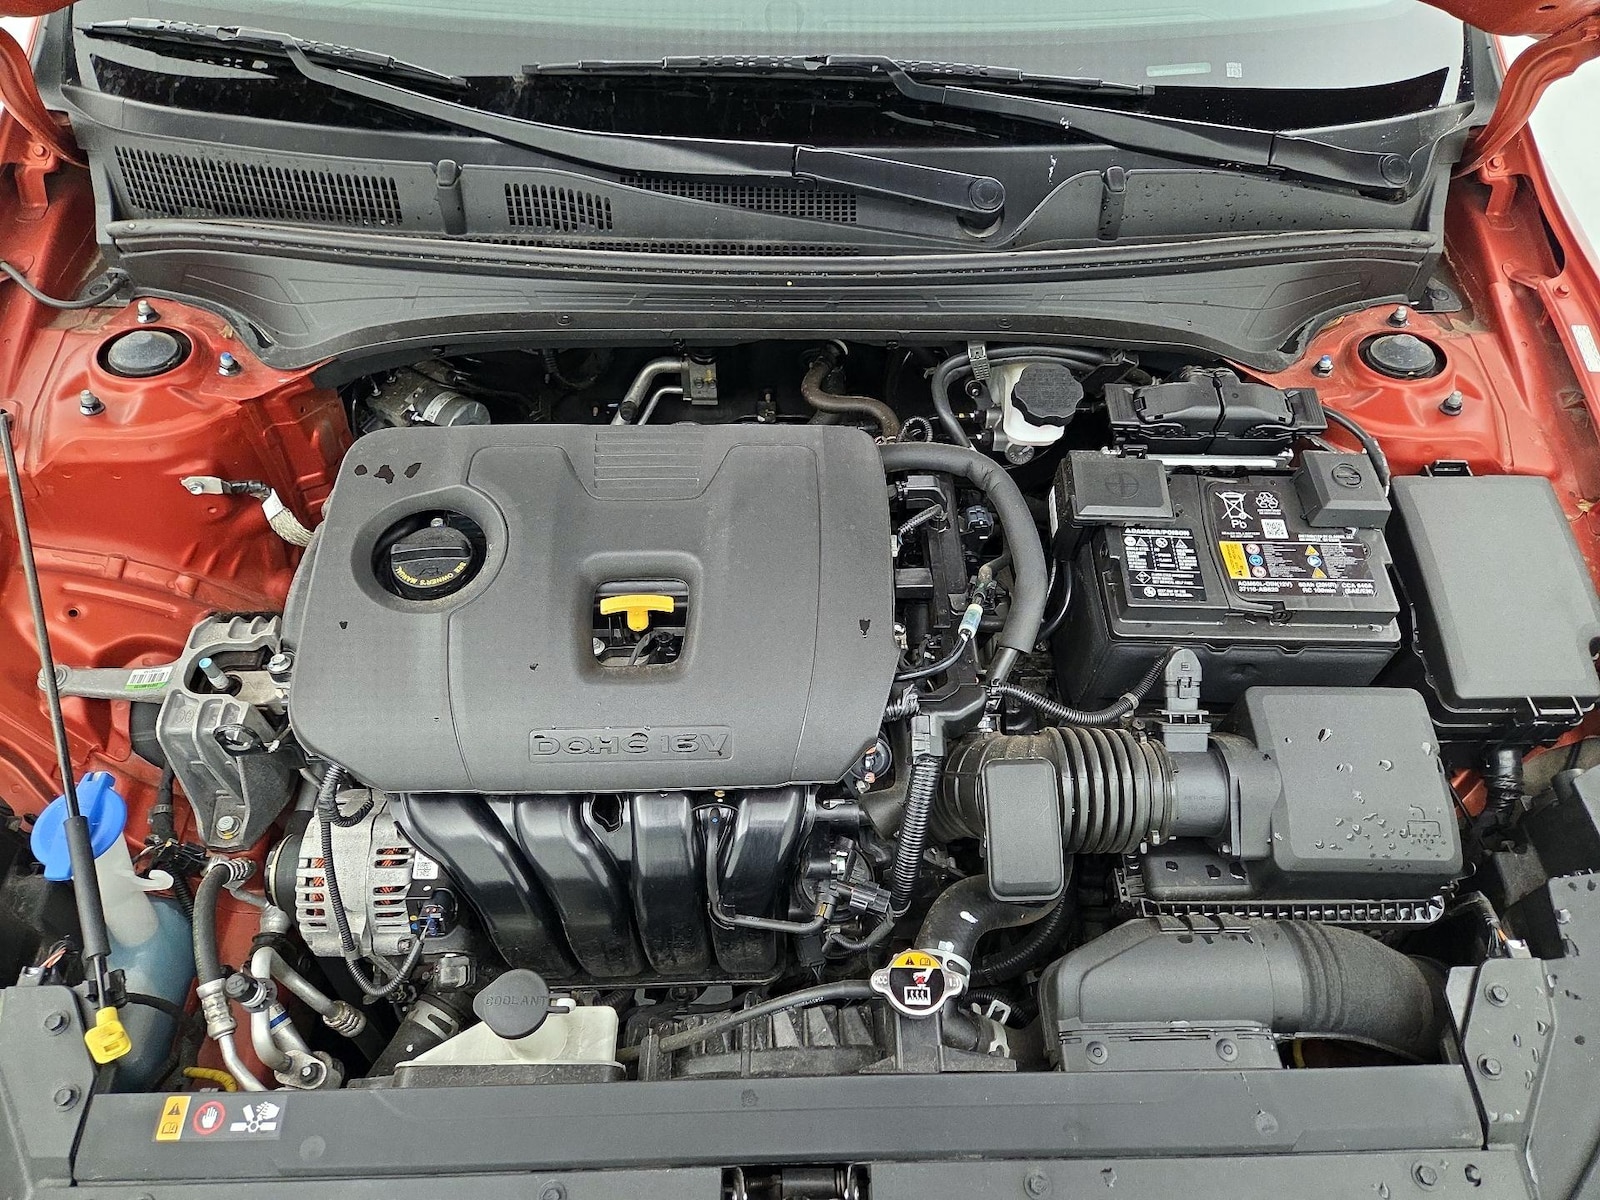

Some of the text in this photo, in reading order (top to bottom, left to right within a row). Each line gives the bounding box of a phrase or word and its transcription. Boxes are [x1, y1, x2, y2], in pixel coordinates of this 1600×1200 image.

[1231, 519, 1247, 529] Pb
[395, 565, 418, 584] MANUAL
[532, 732, 727, 756] DOHC 16V
[485, 995, 548, 1007] COOLANT
